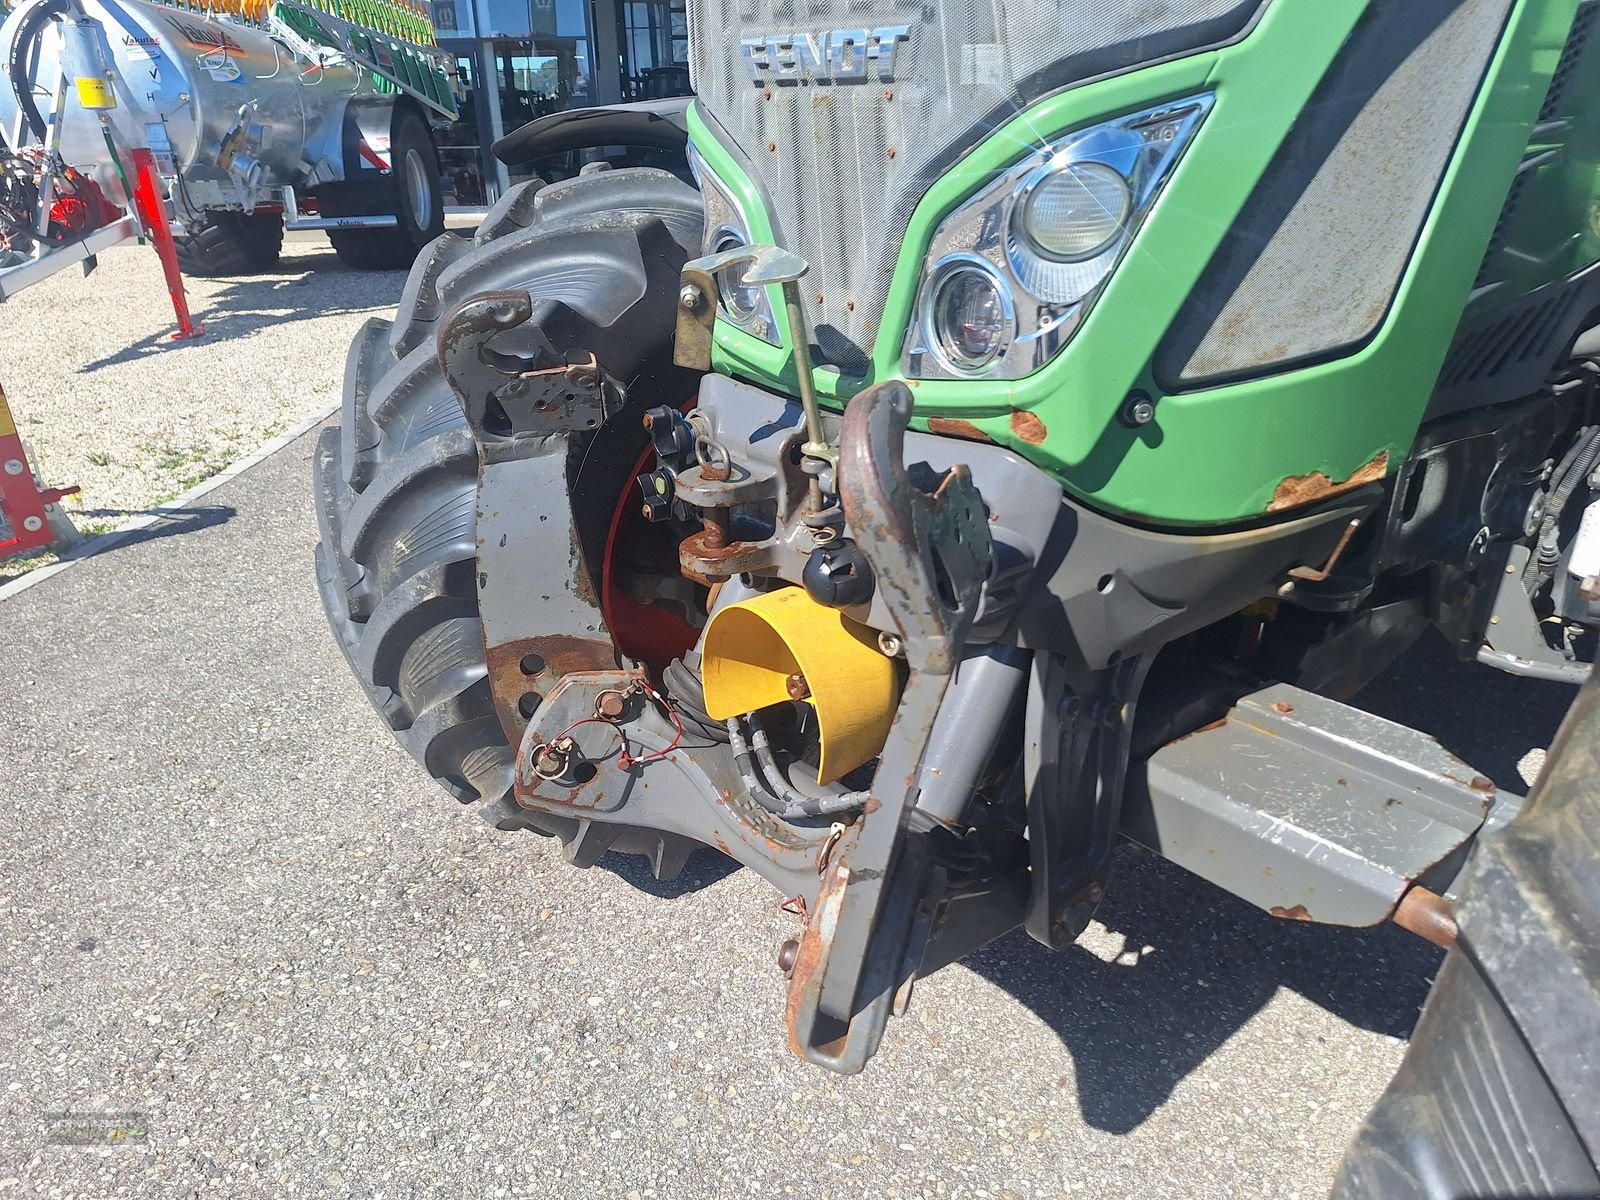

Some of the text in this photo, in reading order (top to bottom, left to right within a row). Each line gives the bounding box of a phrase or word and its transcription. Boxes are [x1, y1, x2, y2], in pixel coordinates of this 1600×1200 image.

[121, 35, 160, 46] Vakutec
[740, 24, 912, 88] FENDT
[146, 92, 155, 102] H
[161, 113, 168, 123] L
